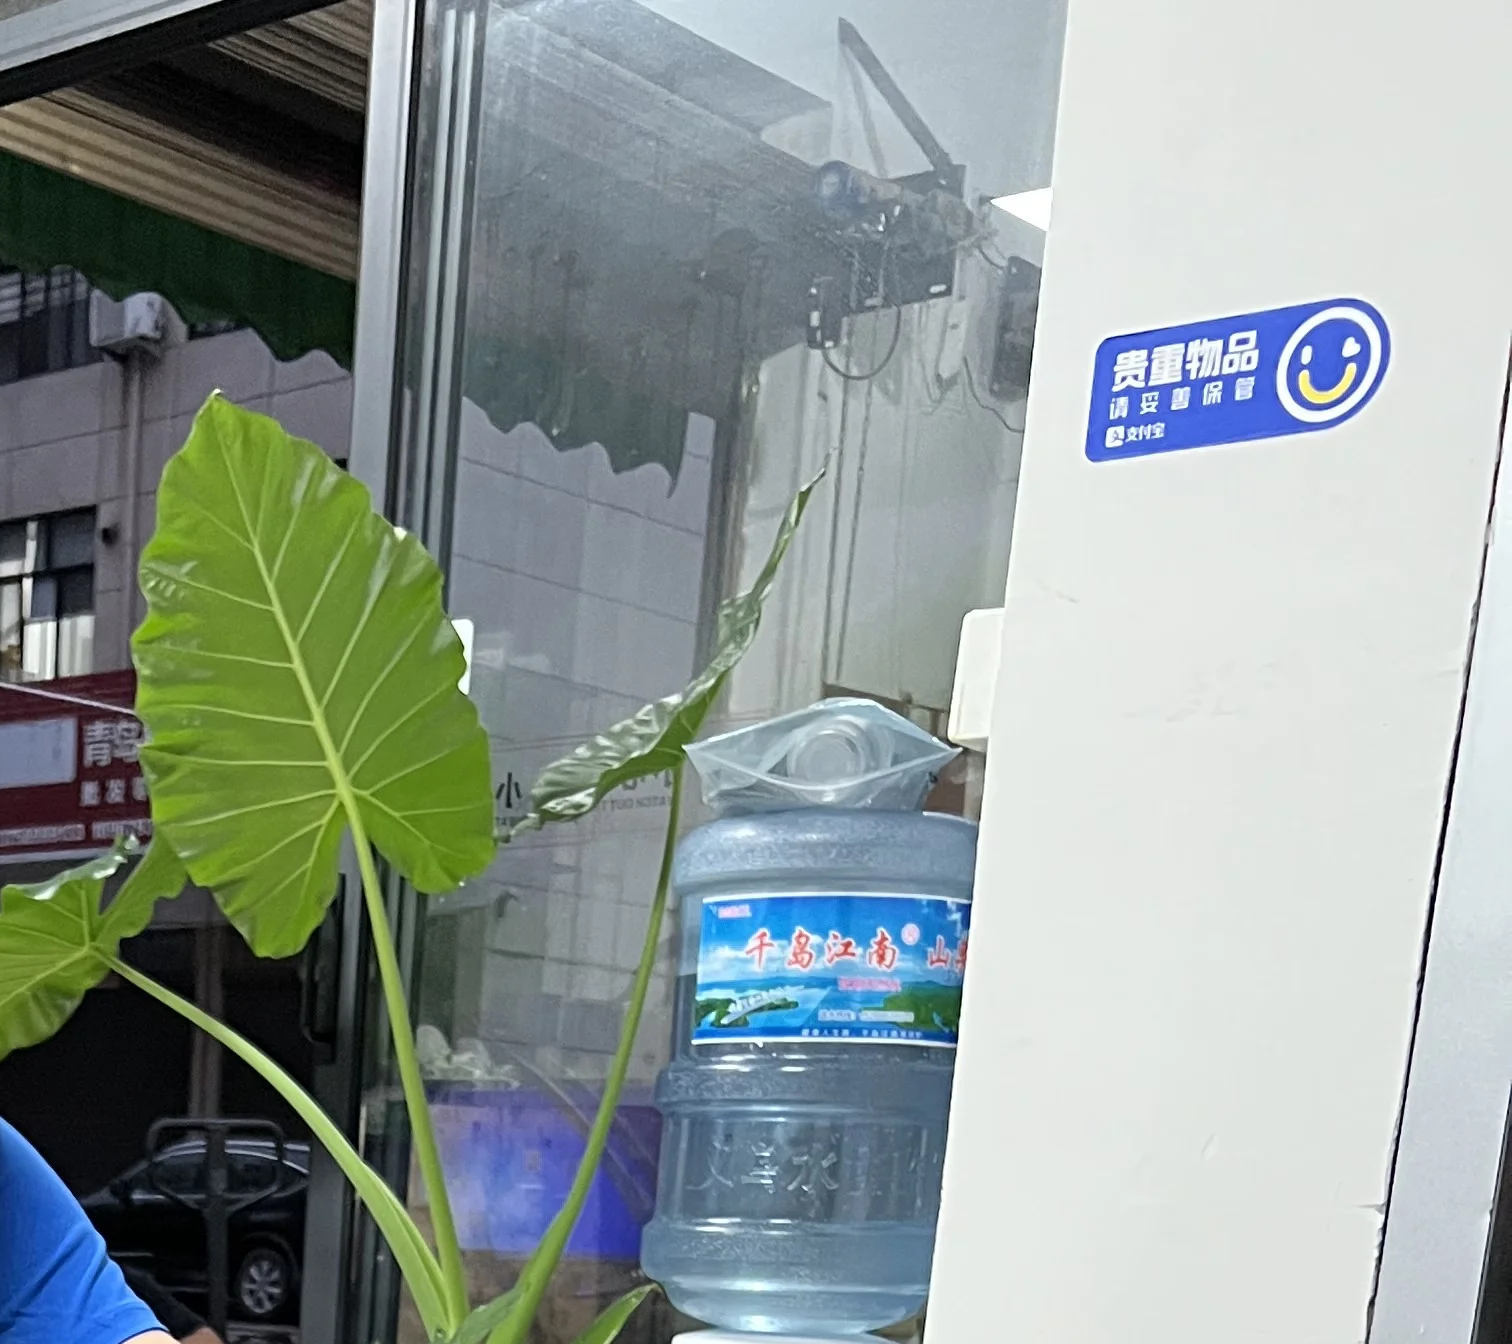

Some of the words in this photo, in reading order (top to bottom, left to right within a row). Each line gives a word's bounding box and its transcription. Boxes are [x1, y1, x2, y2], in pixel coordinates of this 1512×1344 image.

[1112, 329, 1259, 393] 贵重物品
[1108, 376, 1255, 420] 请妥善保管
[1124, 422, 1166, 443] 支付宝
[744, 926, 899, 972] 千岛江南
